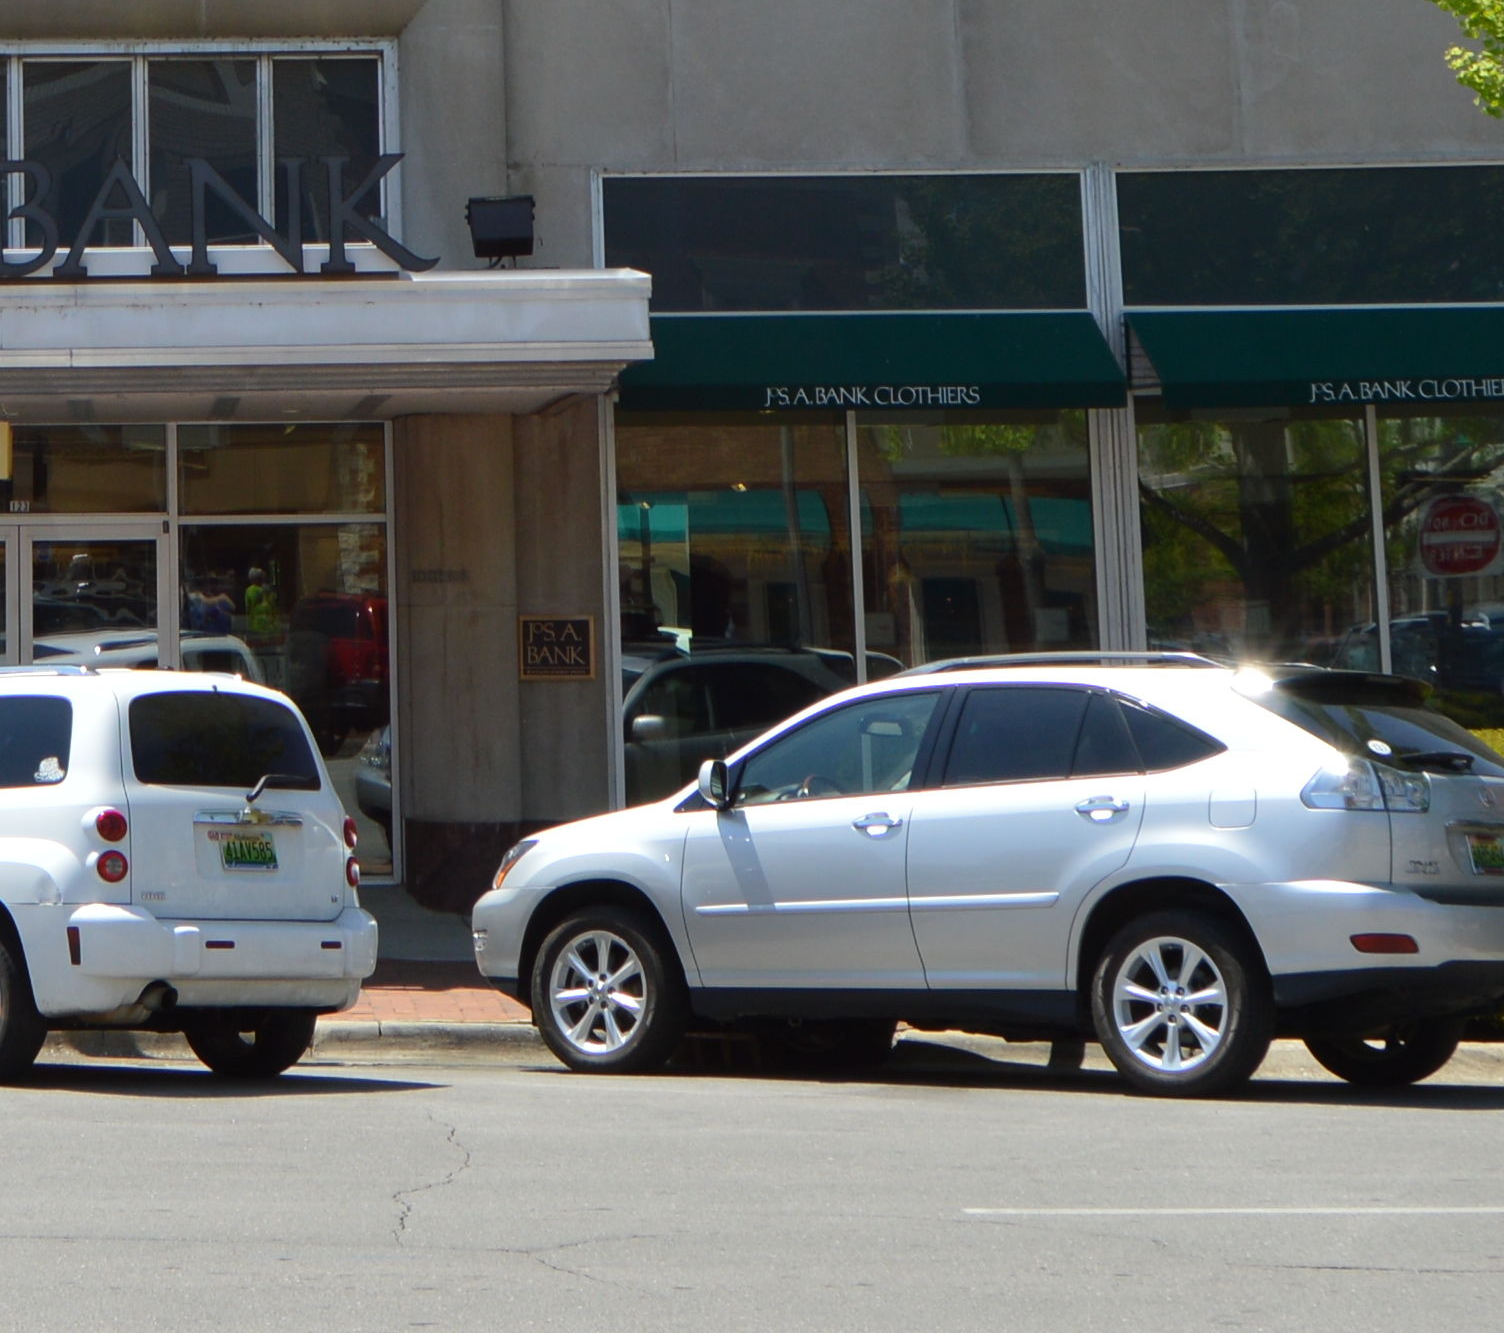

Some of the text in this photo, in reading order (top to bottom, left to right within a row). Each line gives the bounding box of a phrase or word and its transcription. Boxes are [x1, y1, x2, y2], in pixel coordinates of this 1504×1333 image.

[815, 386, 872, 405] BANK
[874, 385, 981, 405] CLOTHIERS
[1360, 381, 1416, 400] BANK
[527, 645, 586, 665] BANK
